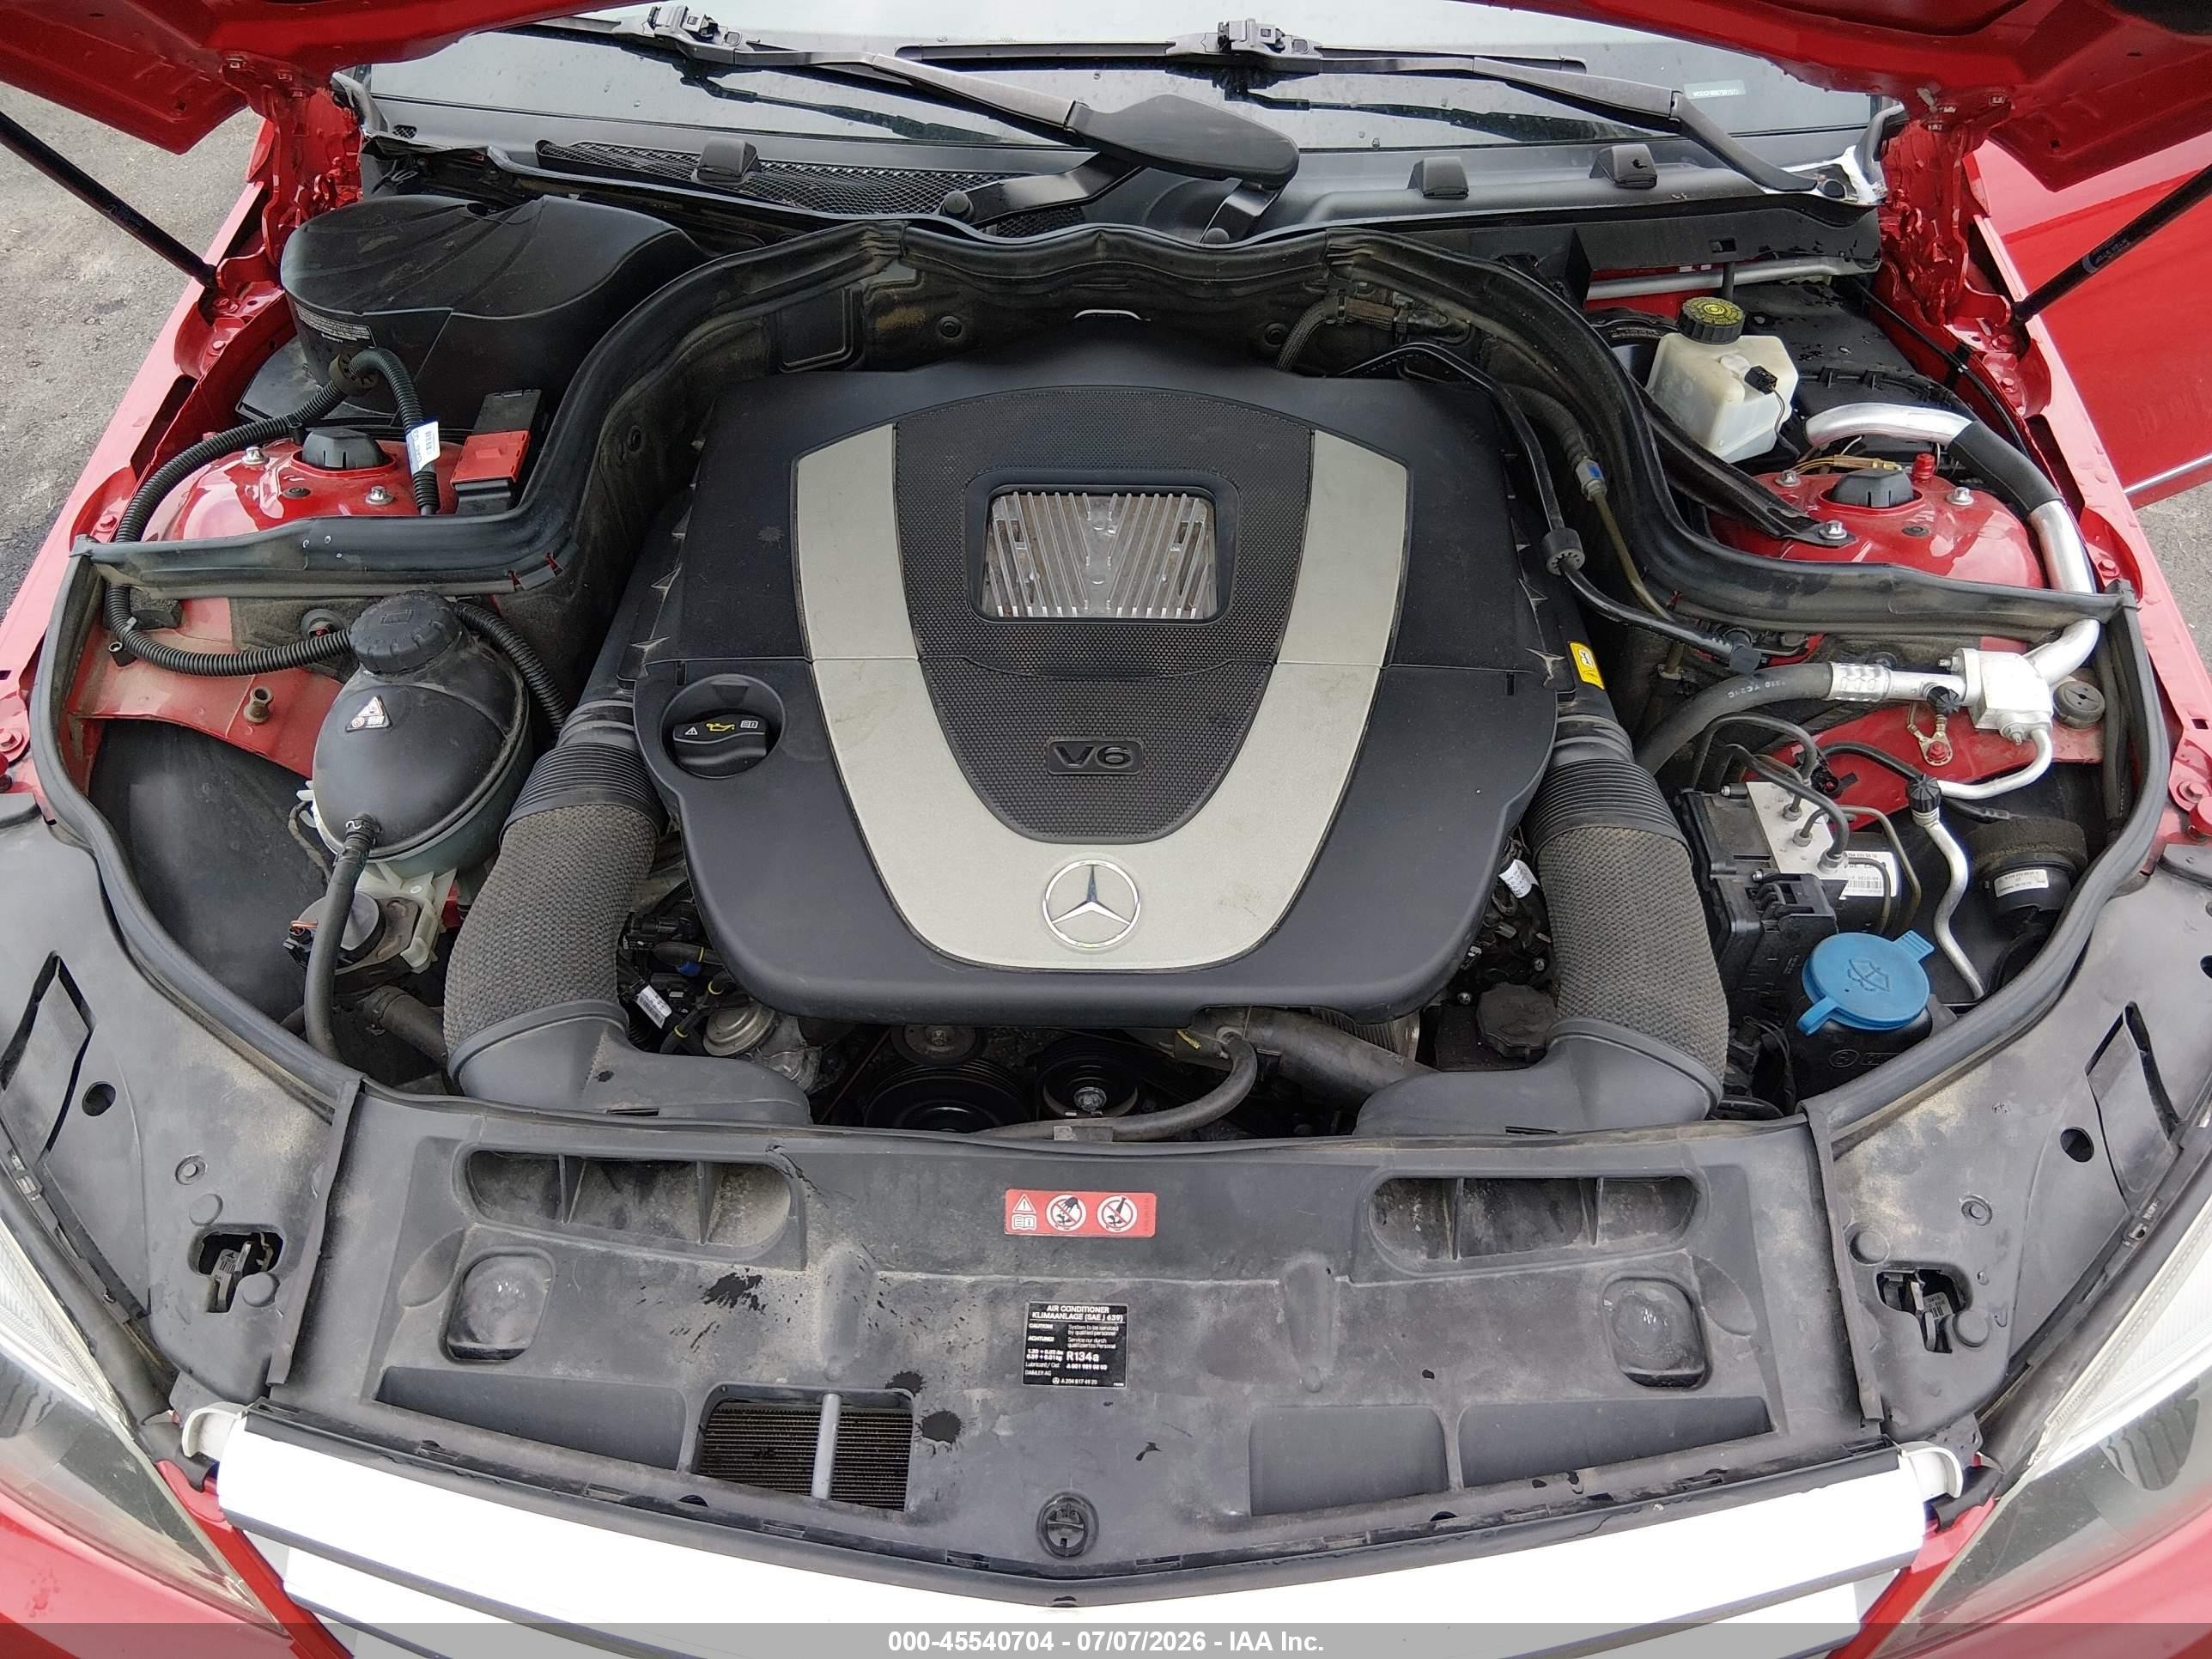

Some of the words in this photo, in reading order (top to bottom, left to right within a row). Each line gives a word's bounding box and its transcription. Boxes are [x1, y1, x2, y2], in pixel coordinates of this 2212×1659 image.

[1054, 744, 1133, 769] V6
[1032, 1312, 1083, 1321] KLIMAANLAGE
[1107, 1314, 1123, 1322] 639)
[1066, 1351, 1099, 1362] R134a
